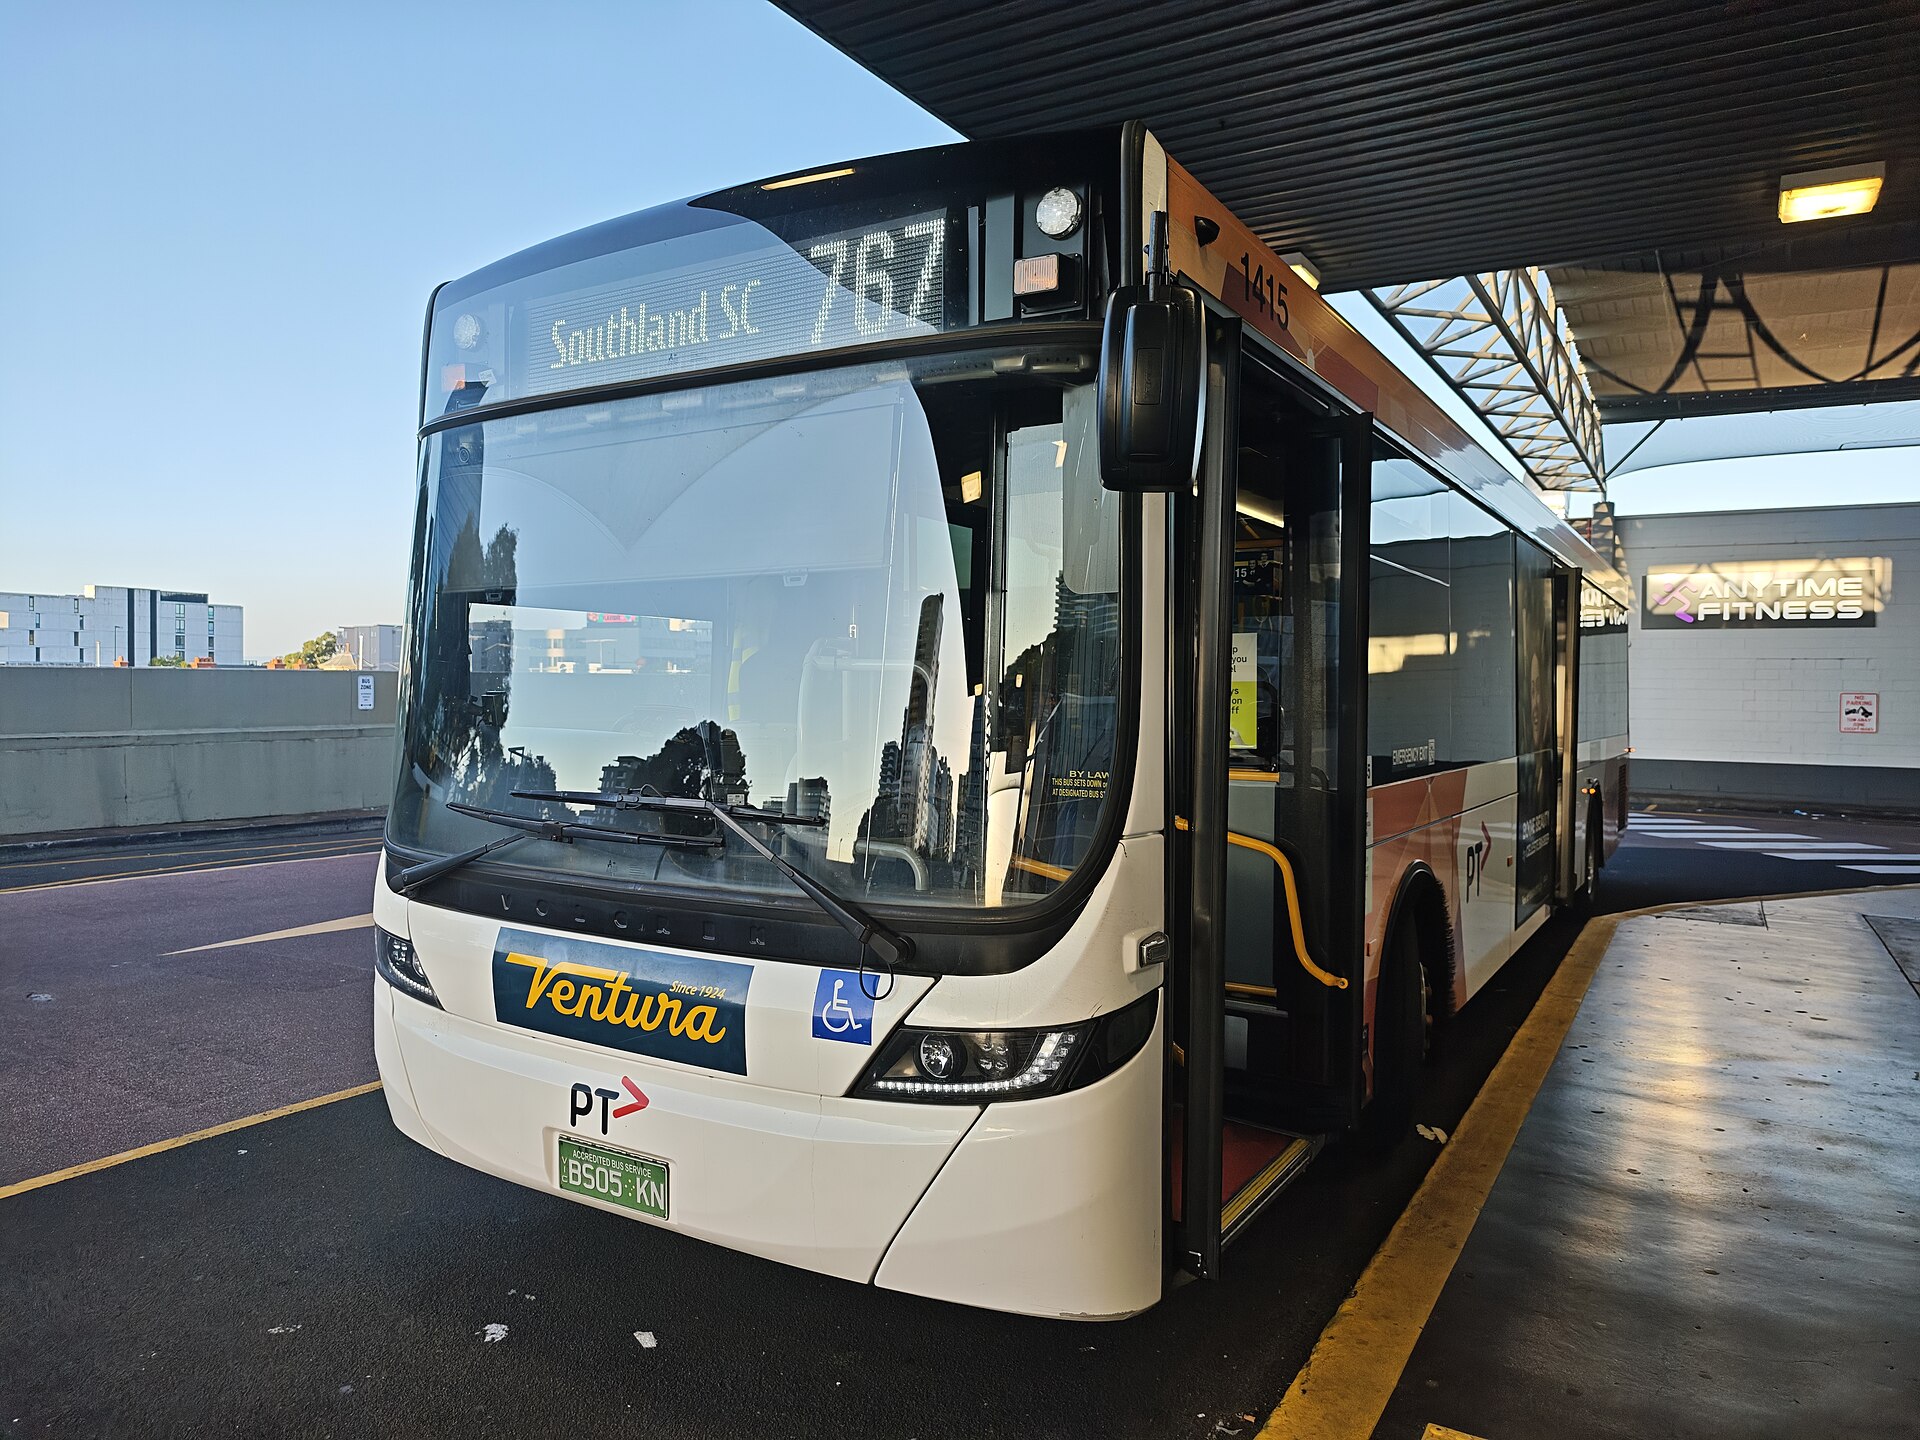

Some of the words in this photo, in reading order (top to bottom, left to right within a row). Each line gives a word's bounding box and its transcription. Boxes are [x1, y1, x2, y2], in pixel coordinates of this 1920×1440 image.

[811, 218, 945, 344] 767
[1241, 252, 1289, 331] 1415
[550, 302, 709, 369] Southland
[718, 279, 761, 340] SC
[1699, 576, 1864, 599] ANYTIME
[1697, 600, 1864, 621] FITNESS
[1052, 778, 1063, 786] THIS
[1063, 778, 1074, 787] BUS
[1074, 779, 1087, 787] SETS
[1087, 779, 1102, 788] DOWN
[1070, 770, 1085, 778] BY
[1052, 788, 1058, 796] AT
[1059, 789, 1089, 798] DESIGNATED
[1089, 790, 1099, 798] BUS
[1466, 841, 1483, 904] PT
[506, 952, 727, 1044] Ventura
[669, 980, 697, 996] Since
[698, 985, 727, 1000] 1924
[570, 1082, 620, 1136] PT
[572, 1149, 611, 1167] ACCREDITED
[611, 1159, 624, 1171] BUS
[624, 1163, 652, 1178] SERVICE
[635, 1177, 665, 1211] KN
